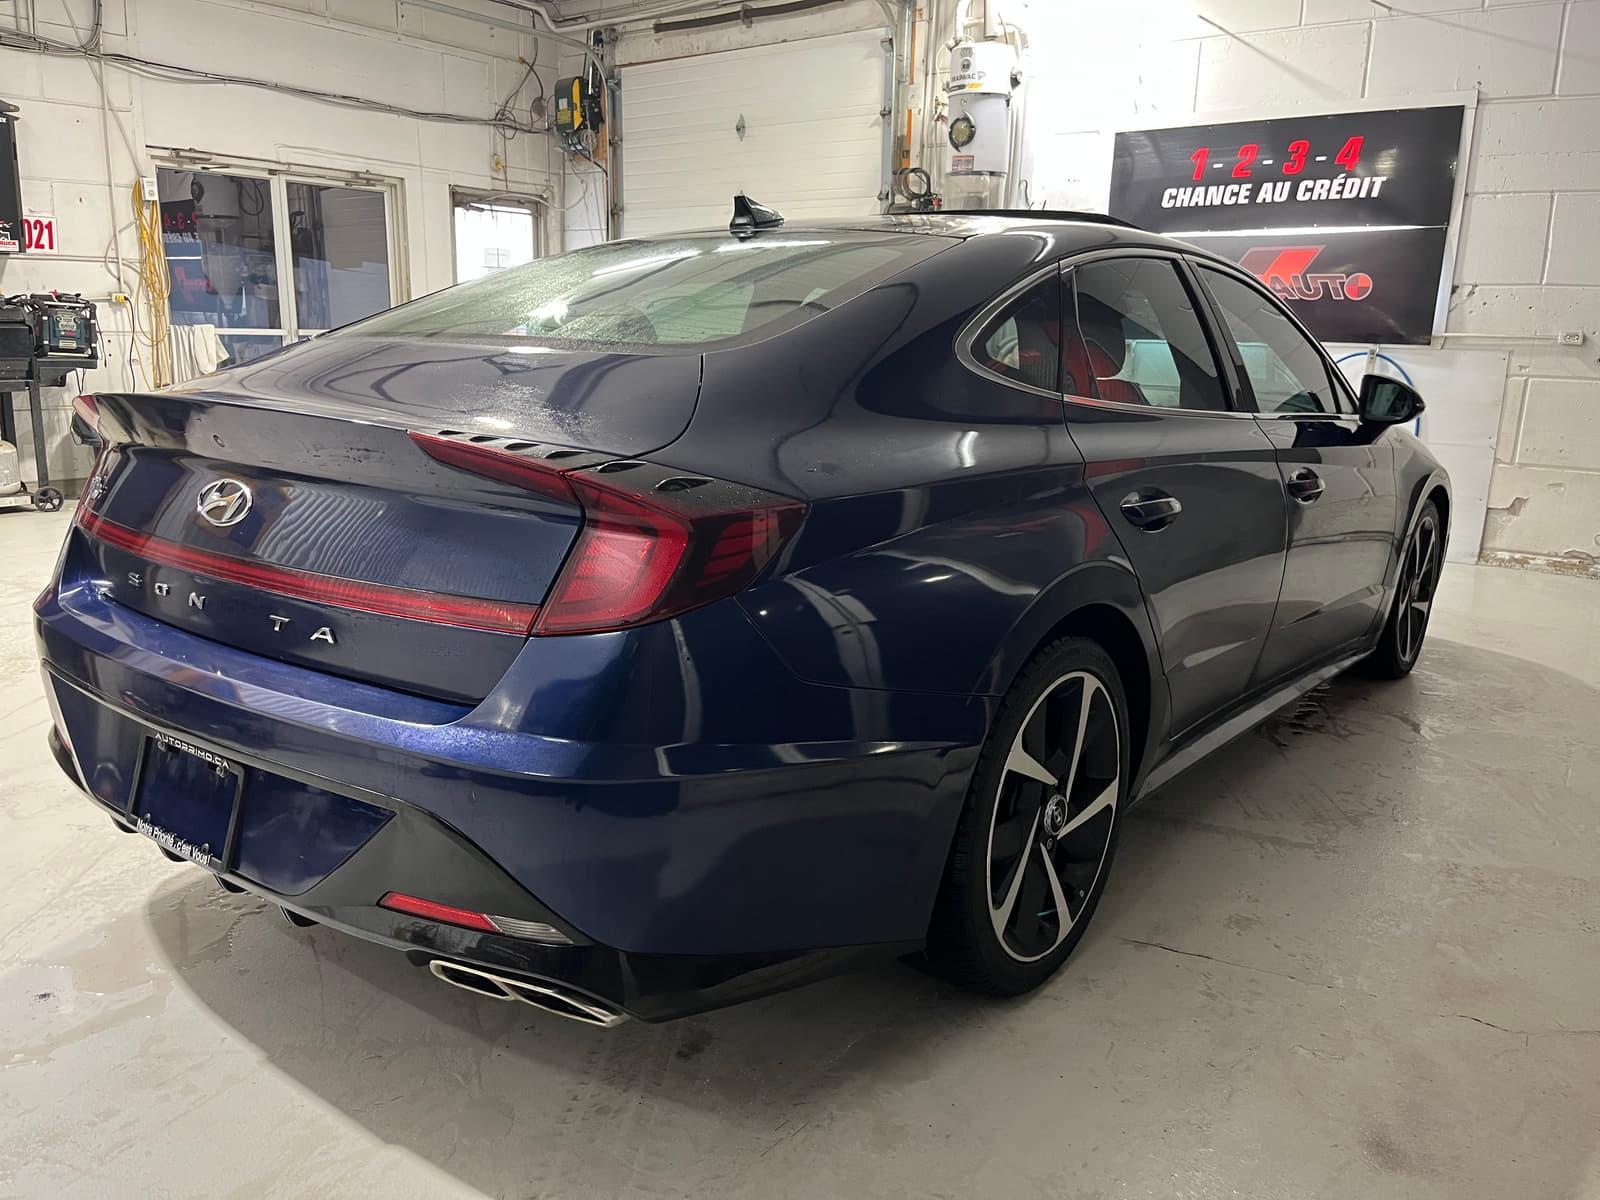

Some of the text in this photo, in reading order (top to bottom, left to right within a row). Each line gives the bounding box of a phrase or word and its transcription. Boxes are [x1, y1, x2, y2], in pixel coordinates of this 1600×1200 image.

[1161, 173, 1387, 208] CHANCE AU CRÉDIT
[1268, 272, 1373, 301] AUTO
[137, 817, 153, 836] Notre
